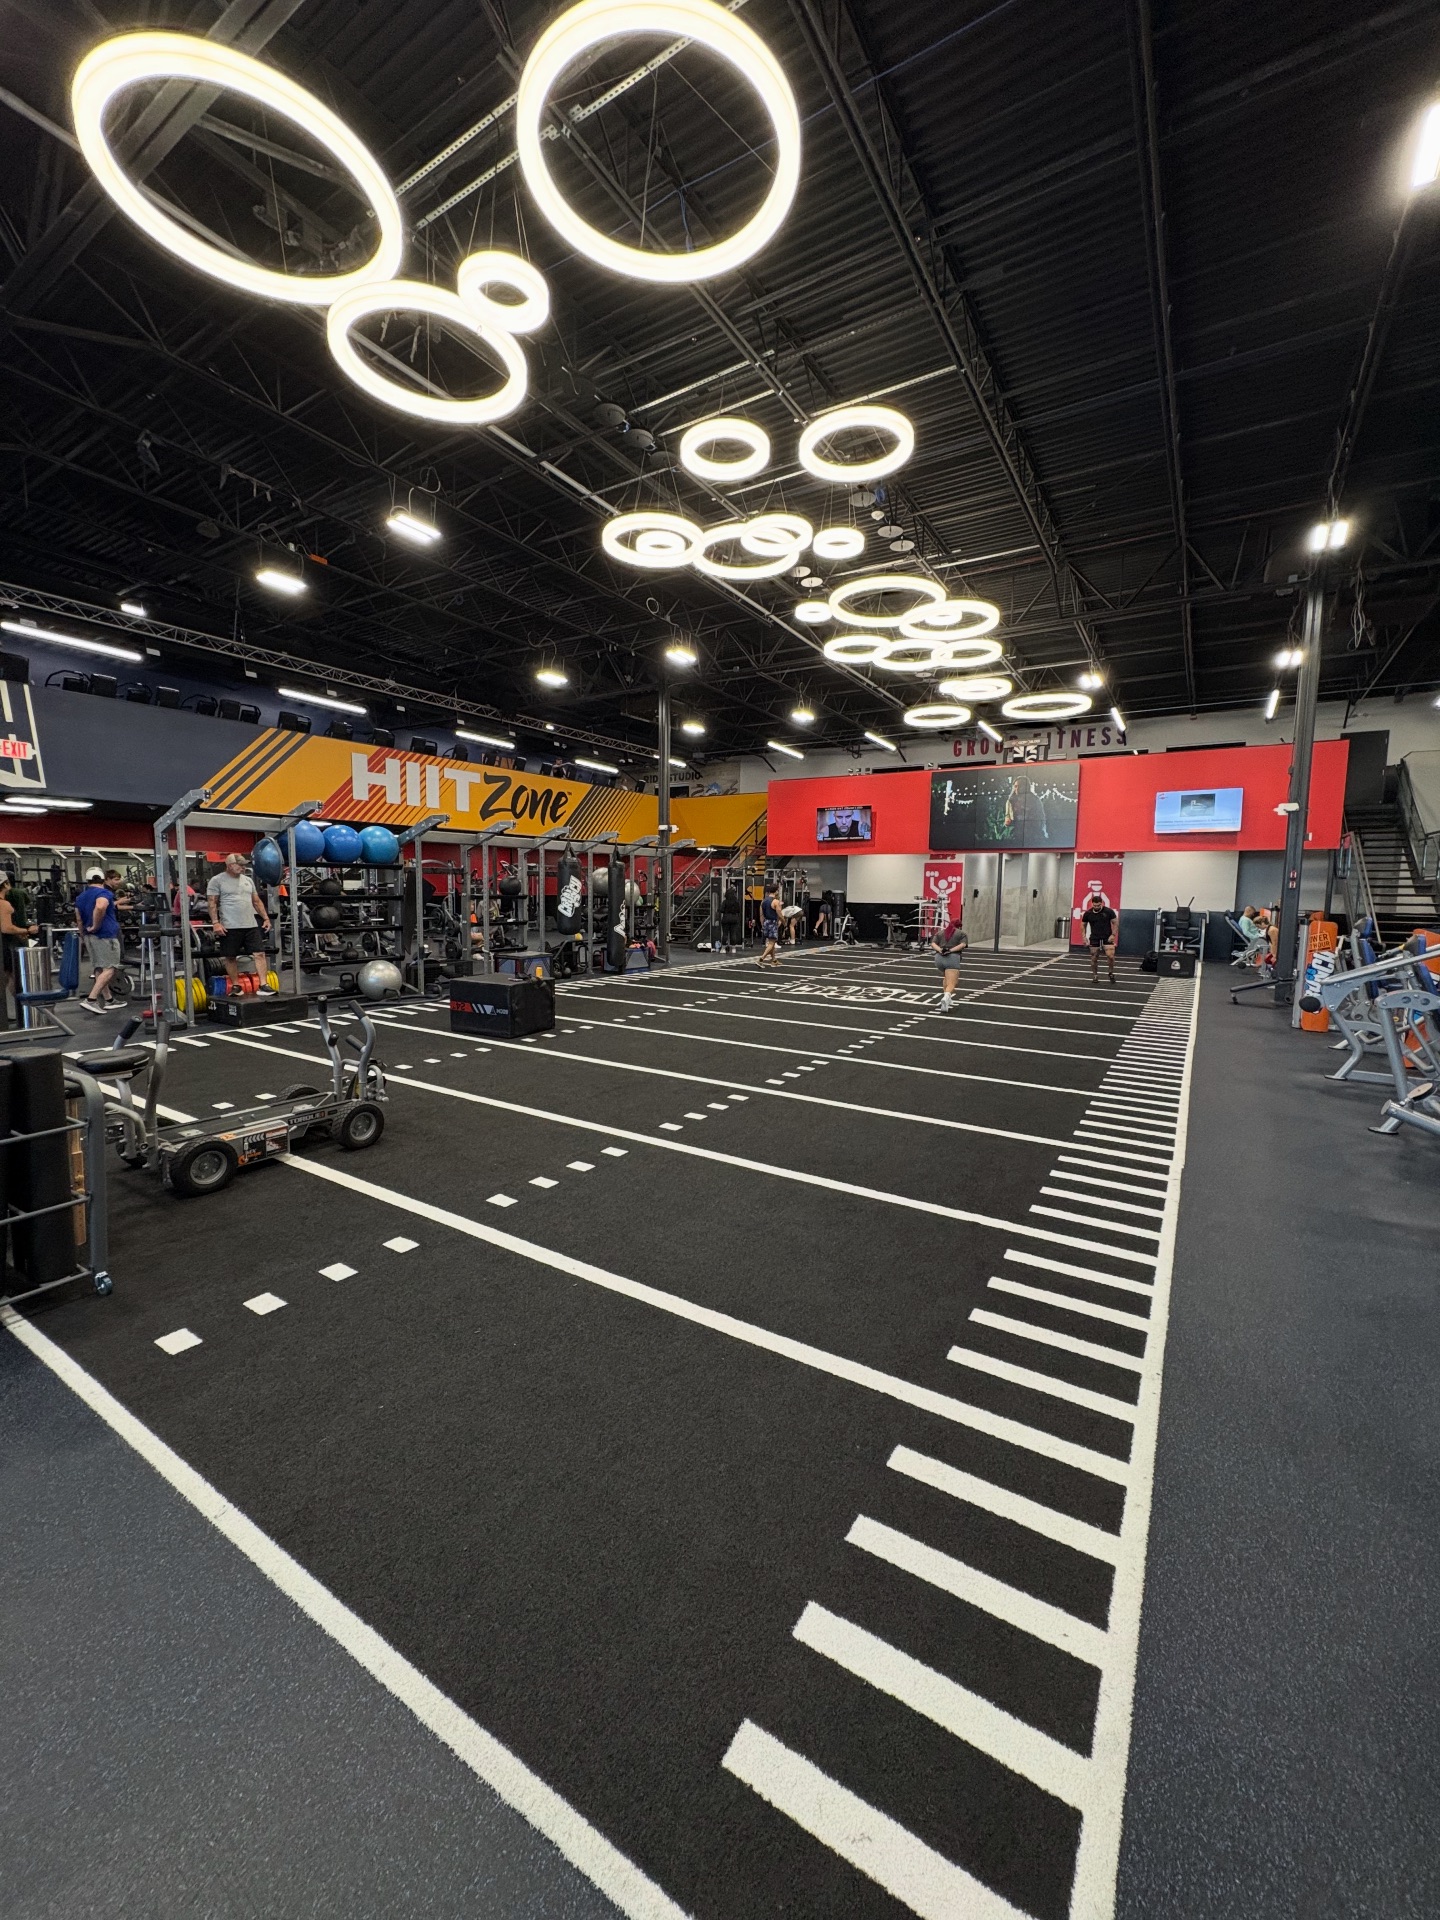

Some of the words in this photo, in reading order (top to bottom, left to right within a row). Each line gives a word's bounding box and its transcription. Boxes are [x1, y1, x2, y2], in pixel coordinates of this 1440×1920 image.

[2, 740, 27, 758] EXIT
[1033, 726, 1126, 752] ITNESS
[352, 752, 480, 812] HIIT
